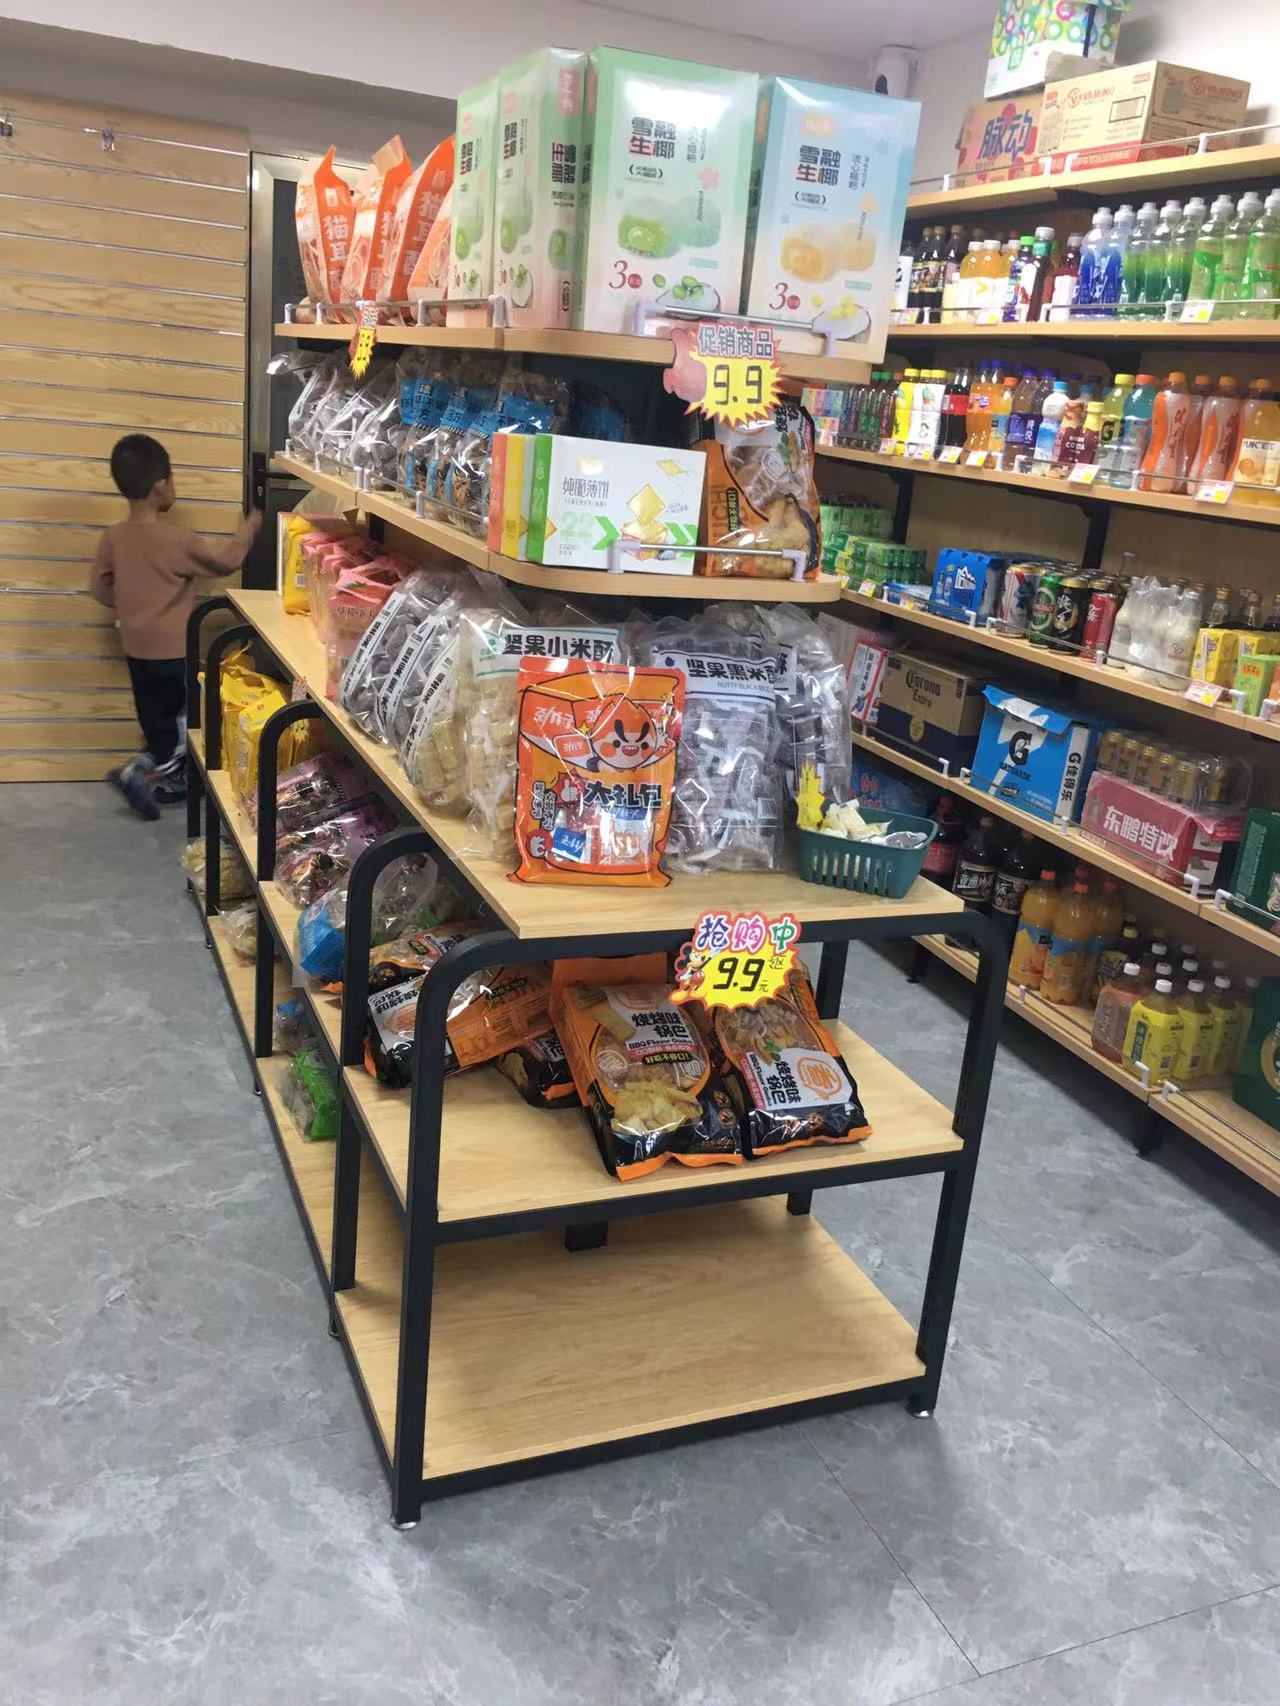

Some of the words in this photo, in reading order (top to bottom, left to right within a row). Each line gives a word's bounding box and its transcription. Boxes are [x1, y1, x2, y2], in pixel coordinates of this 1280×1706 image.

[628, 136, 676, 160] 生椰
[976, 109, 1033, 162] 脉动
[799, 144, 841, 169] 雪融
[796, 163, 839, 187] 生椰
[608, 260, 628, 289] 3
[768, 282, 789, 310] 3
[699, 325, 773, 358] 促销商品
[713, 364, 763, 406] 9.9
[562, 476, 610, 499] 纯脆薄饼
[503, 633, 615, 664] 坚果小米酥
[905, 669, 941, 698] Corona
[912, 687, 933, 708] Extra
[1000, 761, 1032, 783] GATORADE
[583, 780, 662, 809] 大礼包
[1102, 805, 1179, 862] 东鹏特饮
[696, 915, 796, 951] 抢购中
[712, 956, 765, 992] 9.9
[631, 1011, 684, 1028] 烧烤味
[653, 1024, 689, 1038] 锅巴
[766, 1075, 787, 1105] 锅巴
[775, 1060, 801, 1104] 烧烤味
